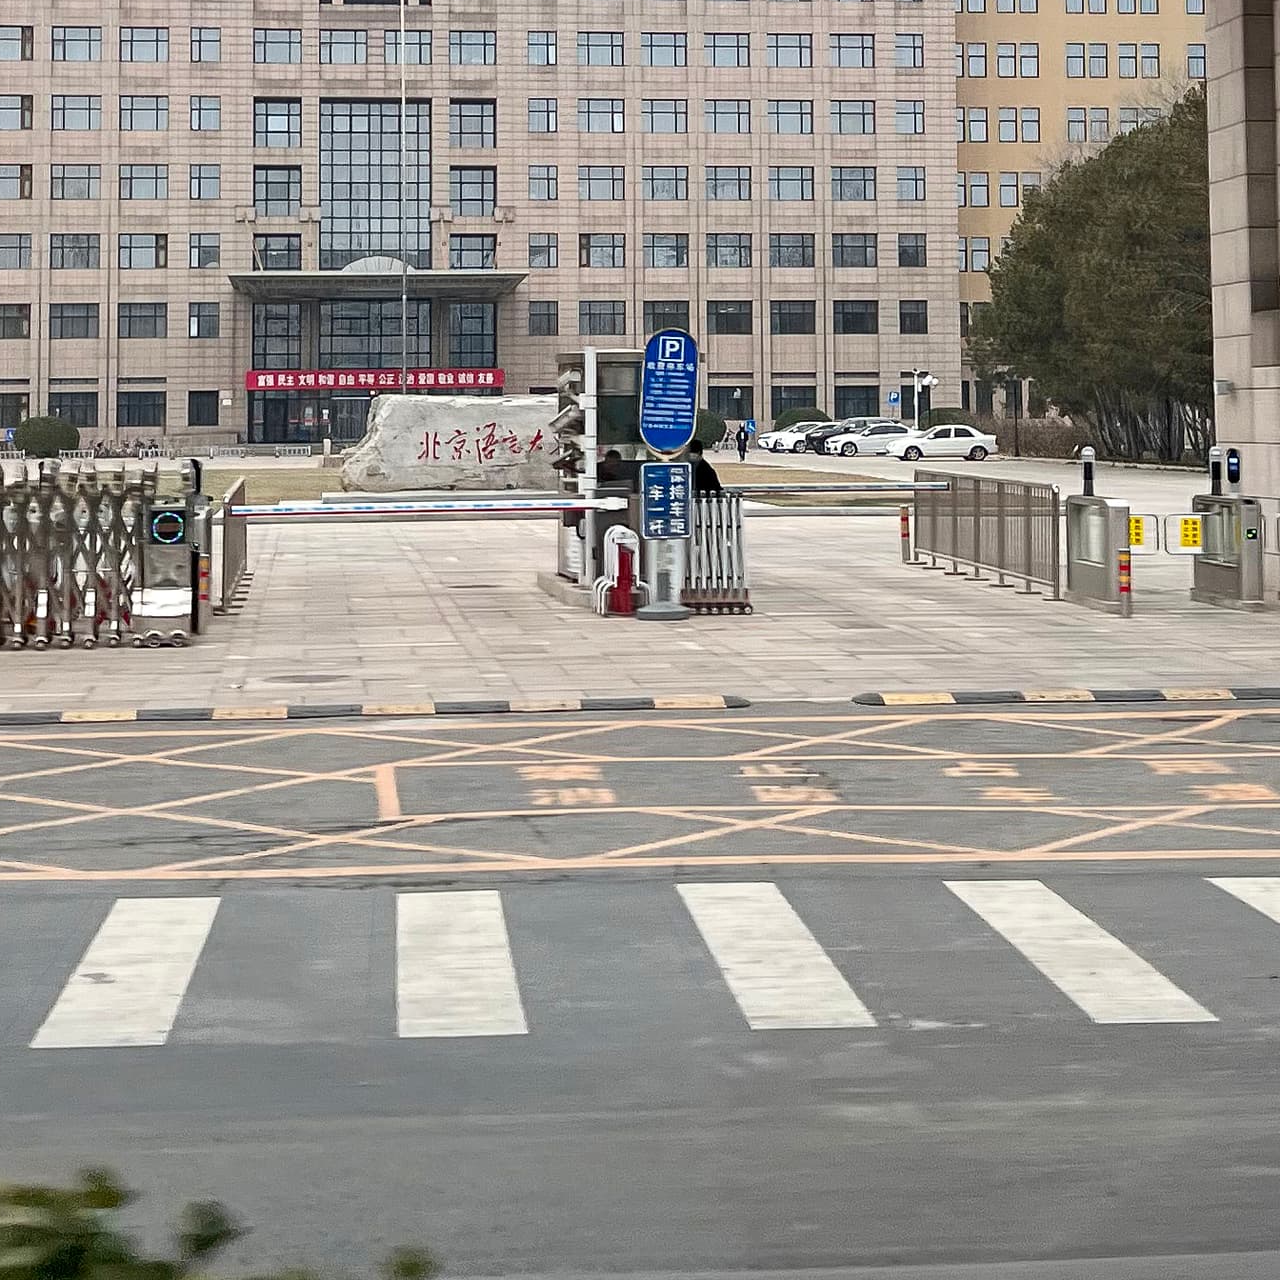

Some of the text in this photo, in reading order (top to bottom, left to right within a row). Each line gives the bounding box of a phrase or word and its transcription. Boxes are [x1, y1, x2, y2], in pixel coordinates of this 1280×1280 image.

[665, 340, 680, 358] P
[258, 374, 274, 387] 富强
[278, 374, 294, 387] 民主
[298, 374, 315, 387] 文明
[318, 374, 334, 387] 和谐
[339, 374, 355, 385] 自由
[359, 374, 375, 385] 平等
[379, 373, 395, 385] 公正
